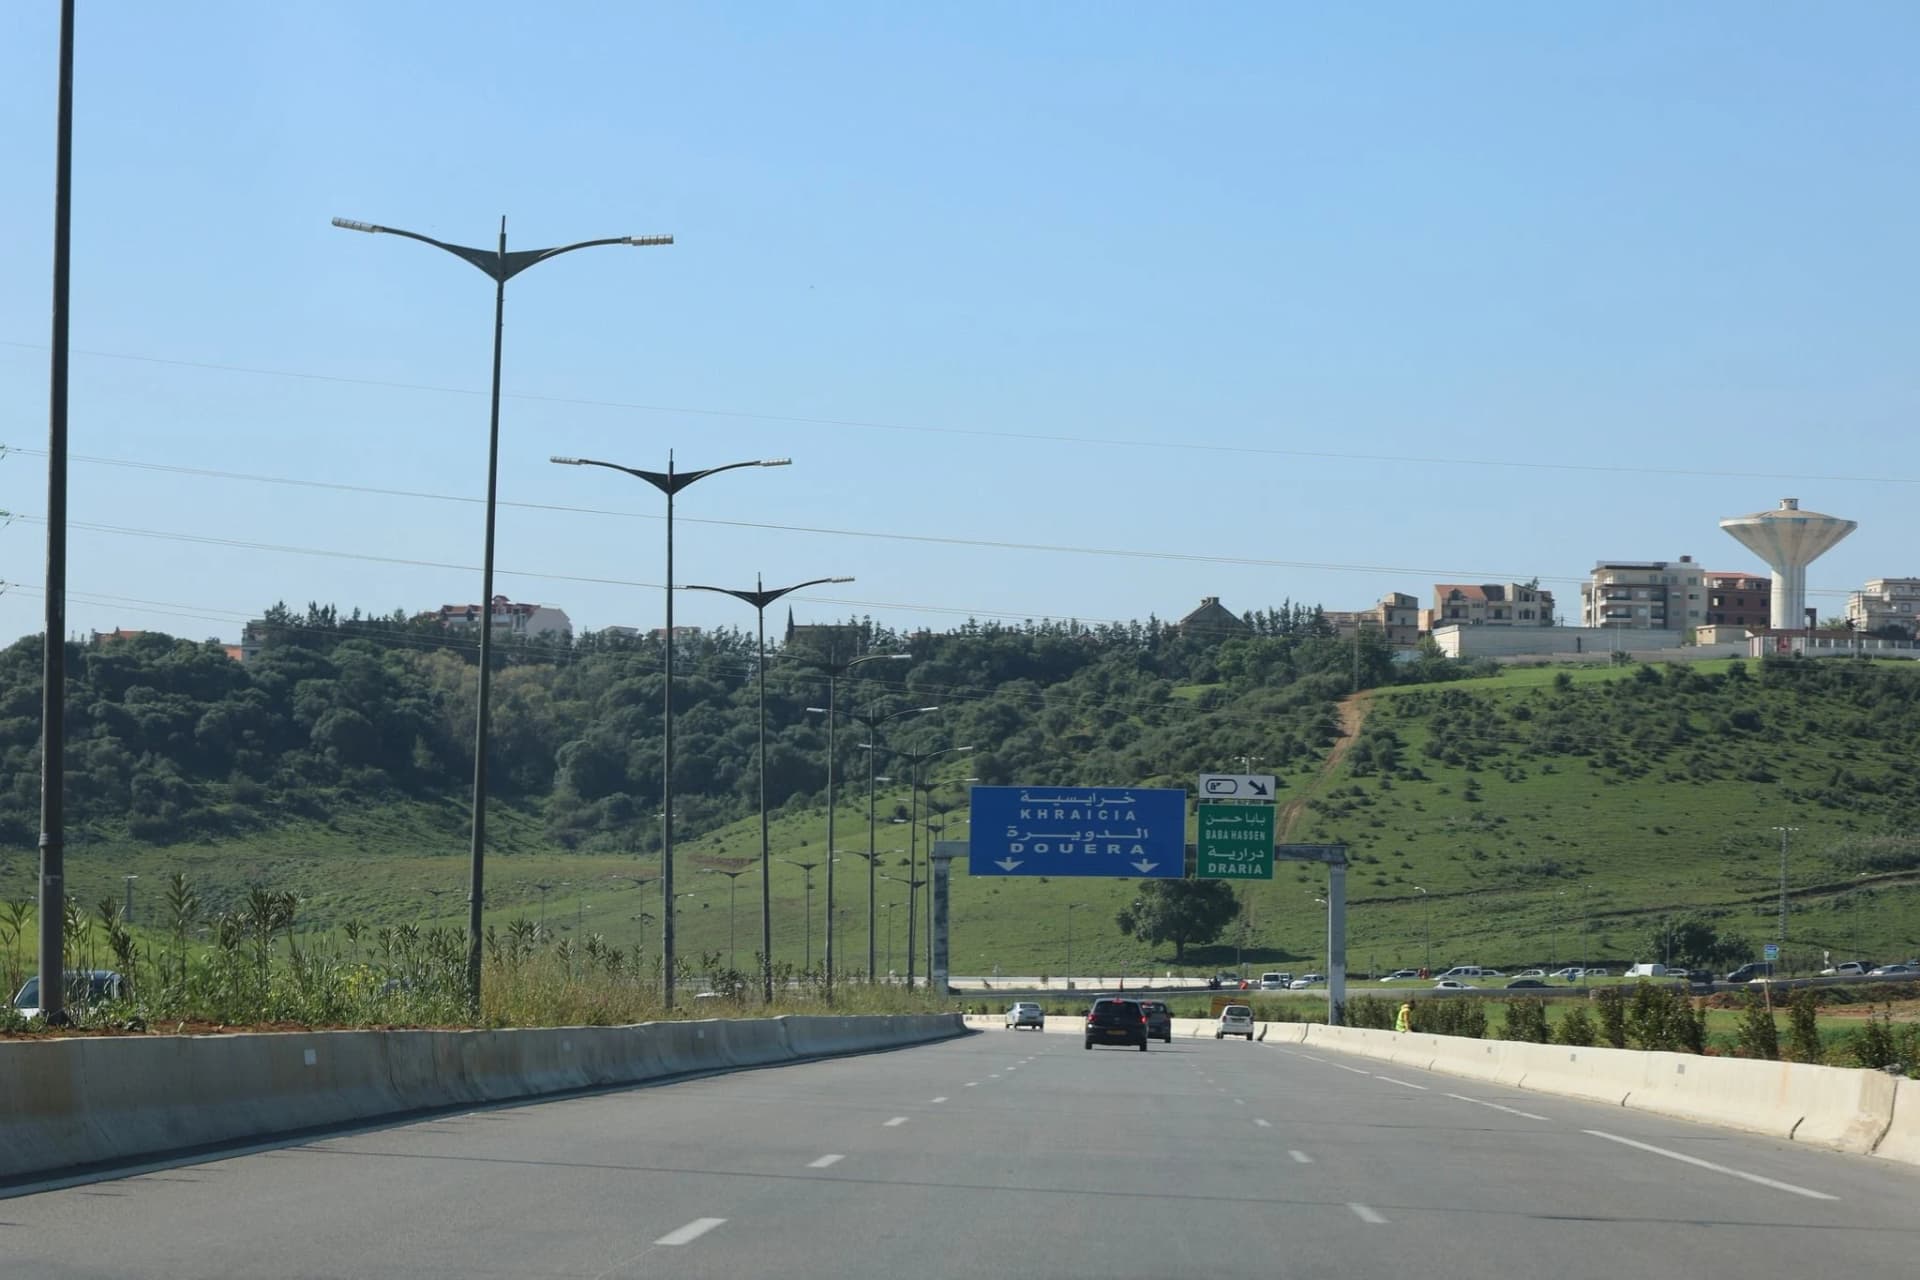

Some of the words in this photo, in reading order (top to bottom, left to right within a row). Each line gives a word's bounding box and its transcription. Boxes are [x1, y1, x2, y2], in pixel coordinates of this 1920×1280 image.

[1020, 808, 1136, 821] KHRAICIA
[1245, 811, 1266, 826] بابا
[1006, 825, 1149, 841] الدويرة
[1205, 829, 1229, 840] BABA
[1231, 829, 1266, 841] HASSEN
[1010, 843, 1144, 854] DOUERA
[1207, 845, 1265, 862] درارية
[1208, 863, 1263, 874] DRARIA
